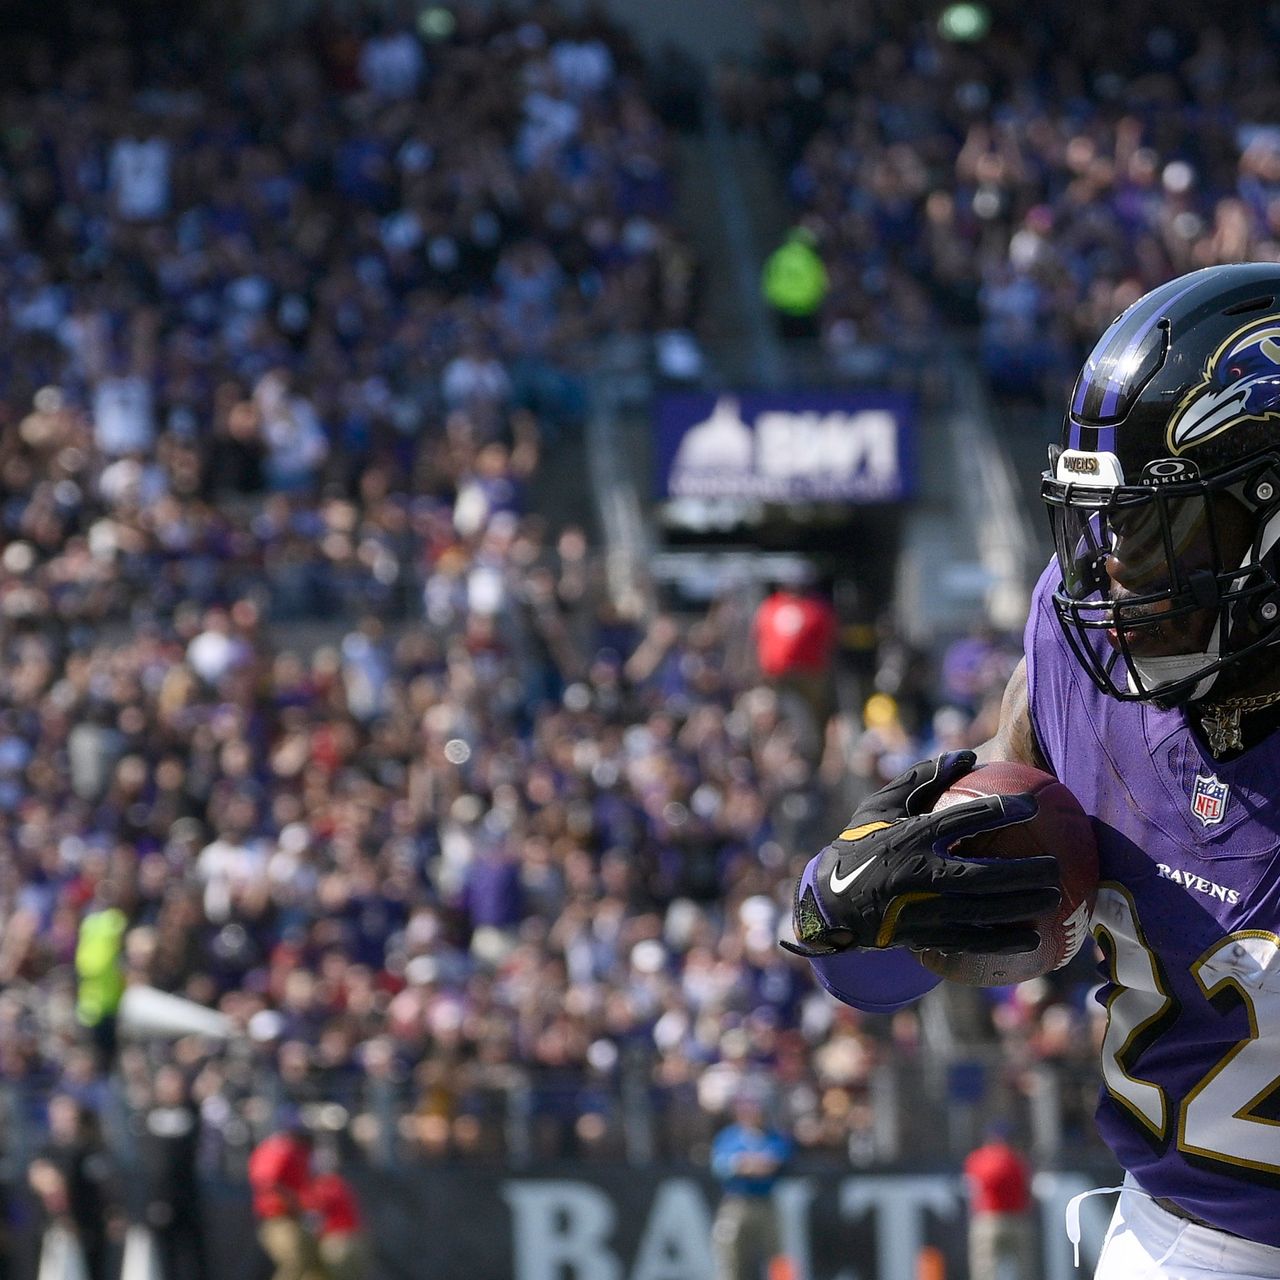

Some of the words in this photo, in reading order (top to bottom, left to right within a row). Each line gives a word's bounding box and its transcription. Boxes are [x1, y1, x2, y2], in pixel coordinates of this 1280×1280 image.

[1063, 456, 1099, 475] RAVENS
[1143, 472, 1197, 486] OAKLEY
[1195, 794, 1219, 817] NFL
[1156, 863, 1241, 904] RAVENS
